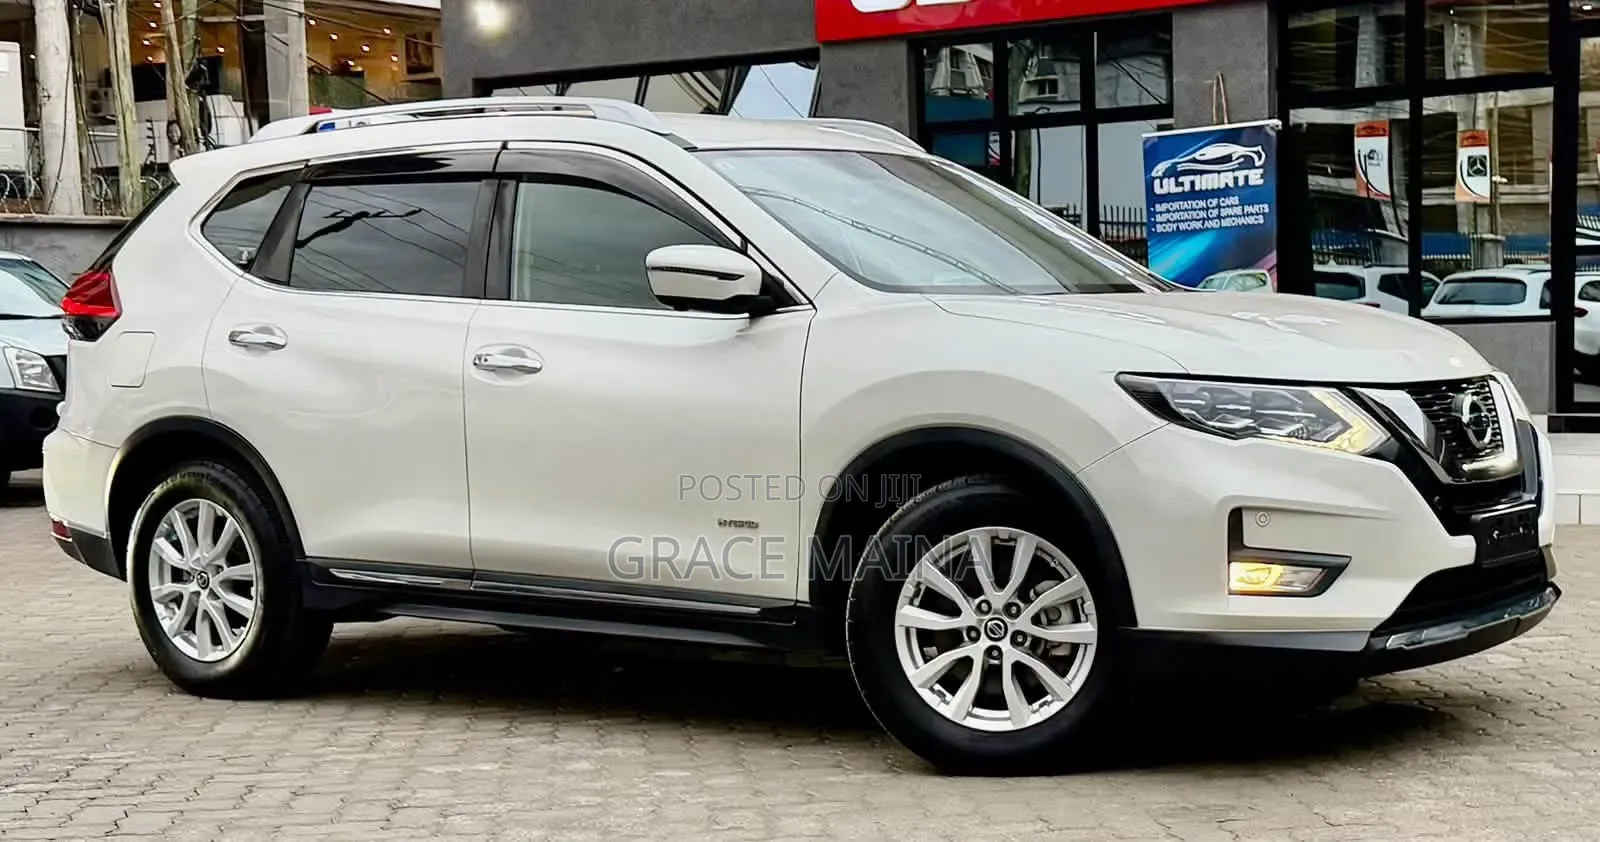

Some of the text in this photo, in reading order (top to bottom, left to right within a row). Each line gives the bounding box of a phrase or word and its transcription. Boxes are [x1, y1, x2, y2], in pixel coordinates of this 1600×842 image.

[1154, 169, 1264, 194] ULTIMATE
[1155, 196, 1239, 211] IMPORTATION OF CARS
[1156, 204, 1269, 222] IMPORTATION OF SPARE PARTS
[1156, 215, 1264, 232] BODY WORK AND MECHANICS
